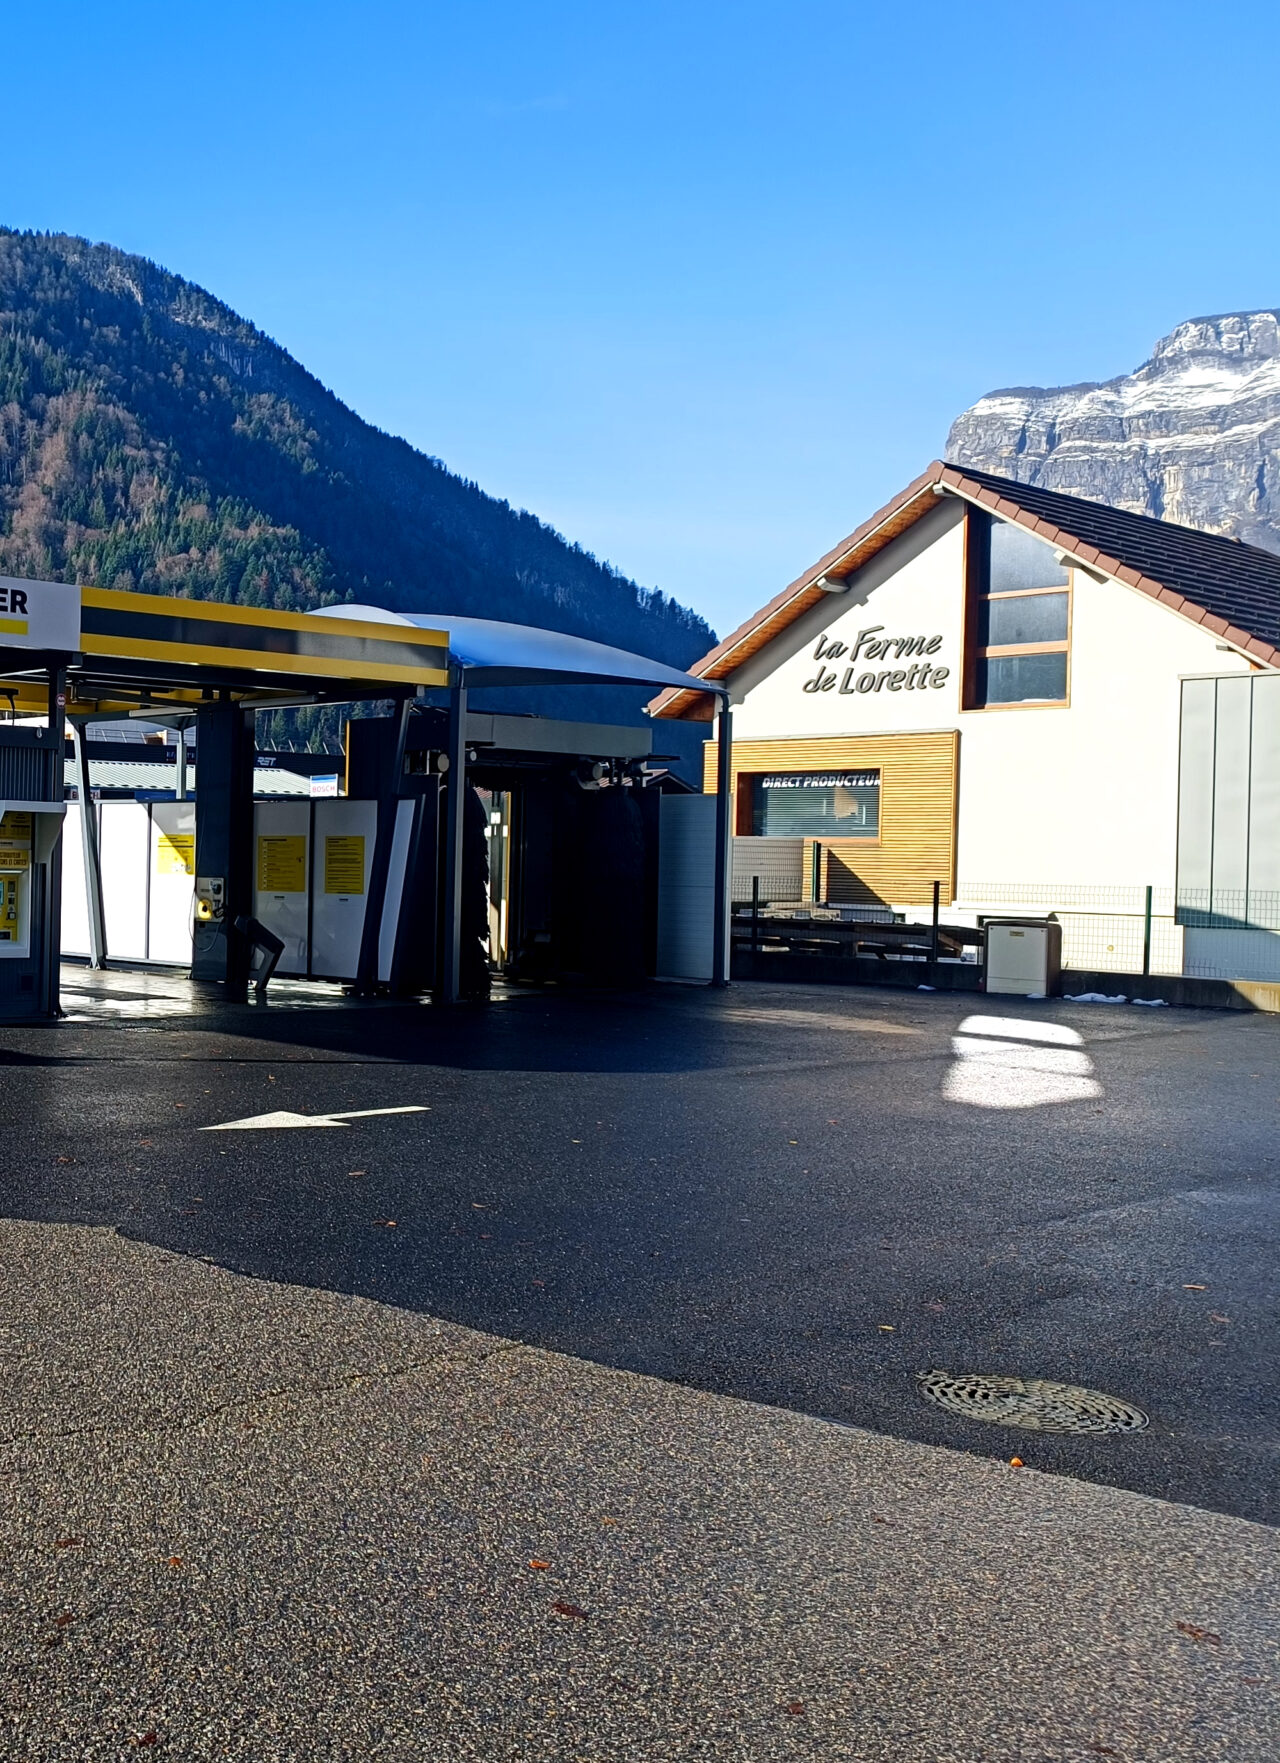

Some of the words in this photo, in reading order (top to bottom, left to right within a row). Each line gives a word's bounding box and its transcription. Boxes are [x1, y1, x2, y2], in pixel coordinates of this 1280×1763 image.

[850, 625, 943, 662] Ferme
[802, 665, 837, 693] de
[838, 663, 950, 695] Lorette
[311, 785, 335, 793] BOSCH
[762, 777, 802, 788] DIRECT
